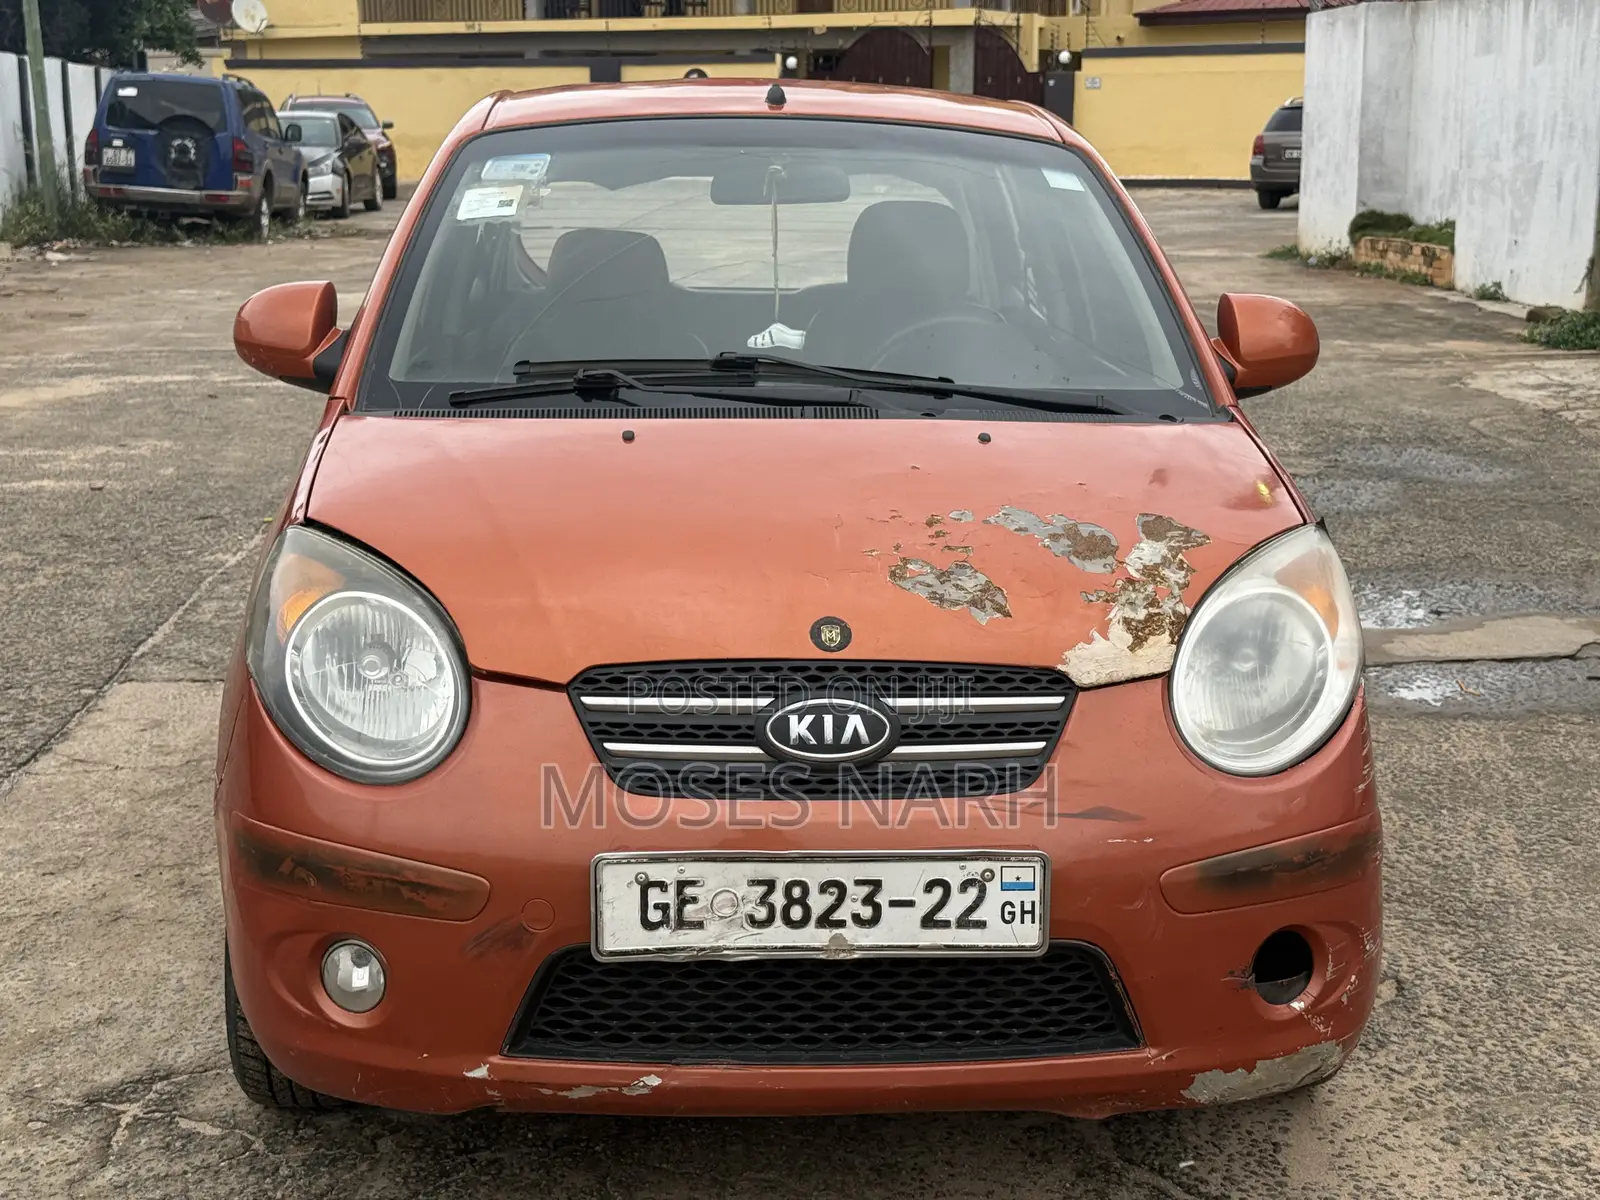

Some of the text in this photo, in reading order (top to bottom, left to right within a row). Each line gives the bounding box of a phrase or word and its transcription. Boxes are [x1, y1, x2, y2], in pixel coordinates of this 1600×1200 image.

[787, 714, 871, 745] KIA
[640, 877, 988, 931] GE 3823-22
[1000, 900, 1036, 925] GH
